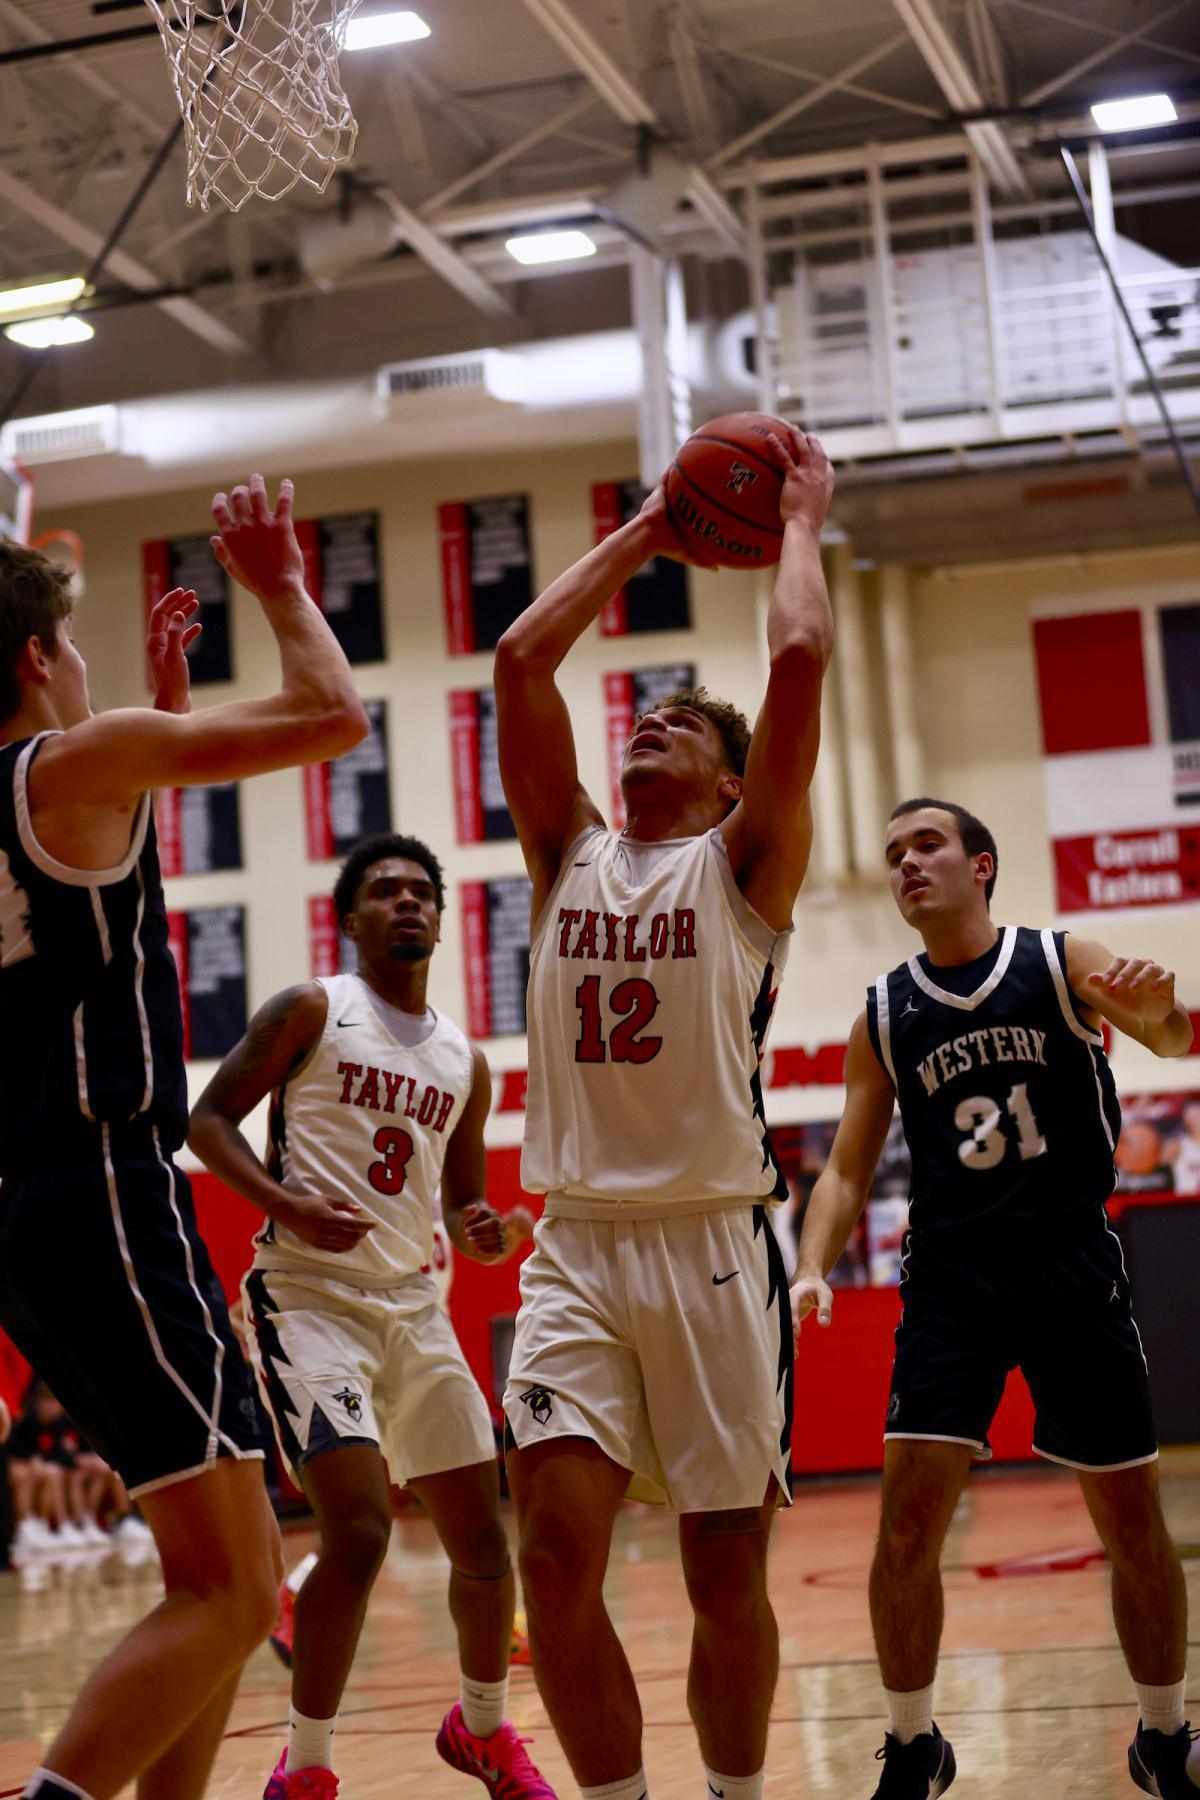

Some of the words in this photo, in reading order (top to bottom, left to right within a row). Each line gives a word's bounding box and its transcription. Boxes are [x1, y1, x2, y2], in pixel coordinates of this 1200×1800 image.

[675, 490, 763, 558] Wilson
[1093, 829, 1180, 869] Carroll
[1088, 869, 1182, 904] Eastern
[558, 907, 697, 962] TAYLOR
[575, 975, 663, 1064] 12
[916, 1026, 1048, 1097] WESTERN
[337, 1061, 455, 1134] TAYLOR
[954, 1082, 1048, 1170] 31
[368, 1126, 415, 1196] 3
